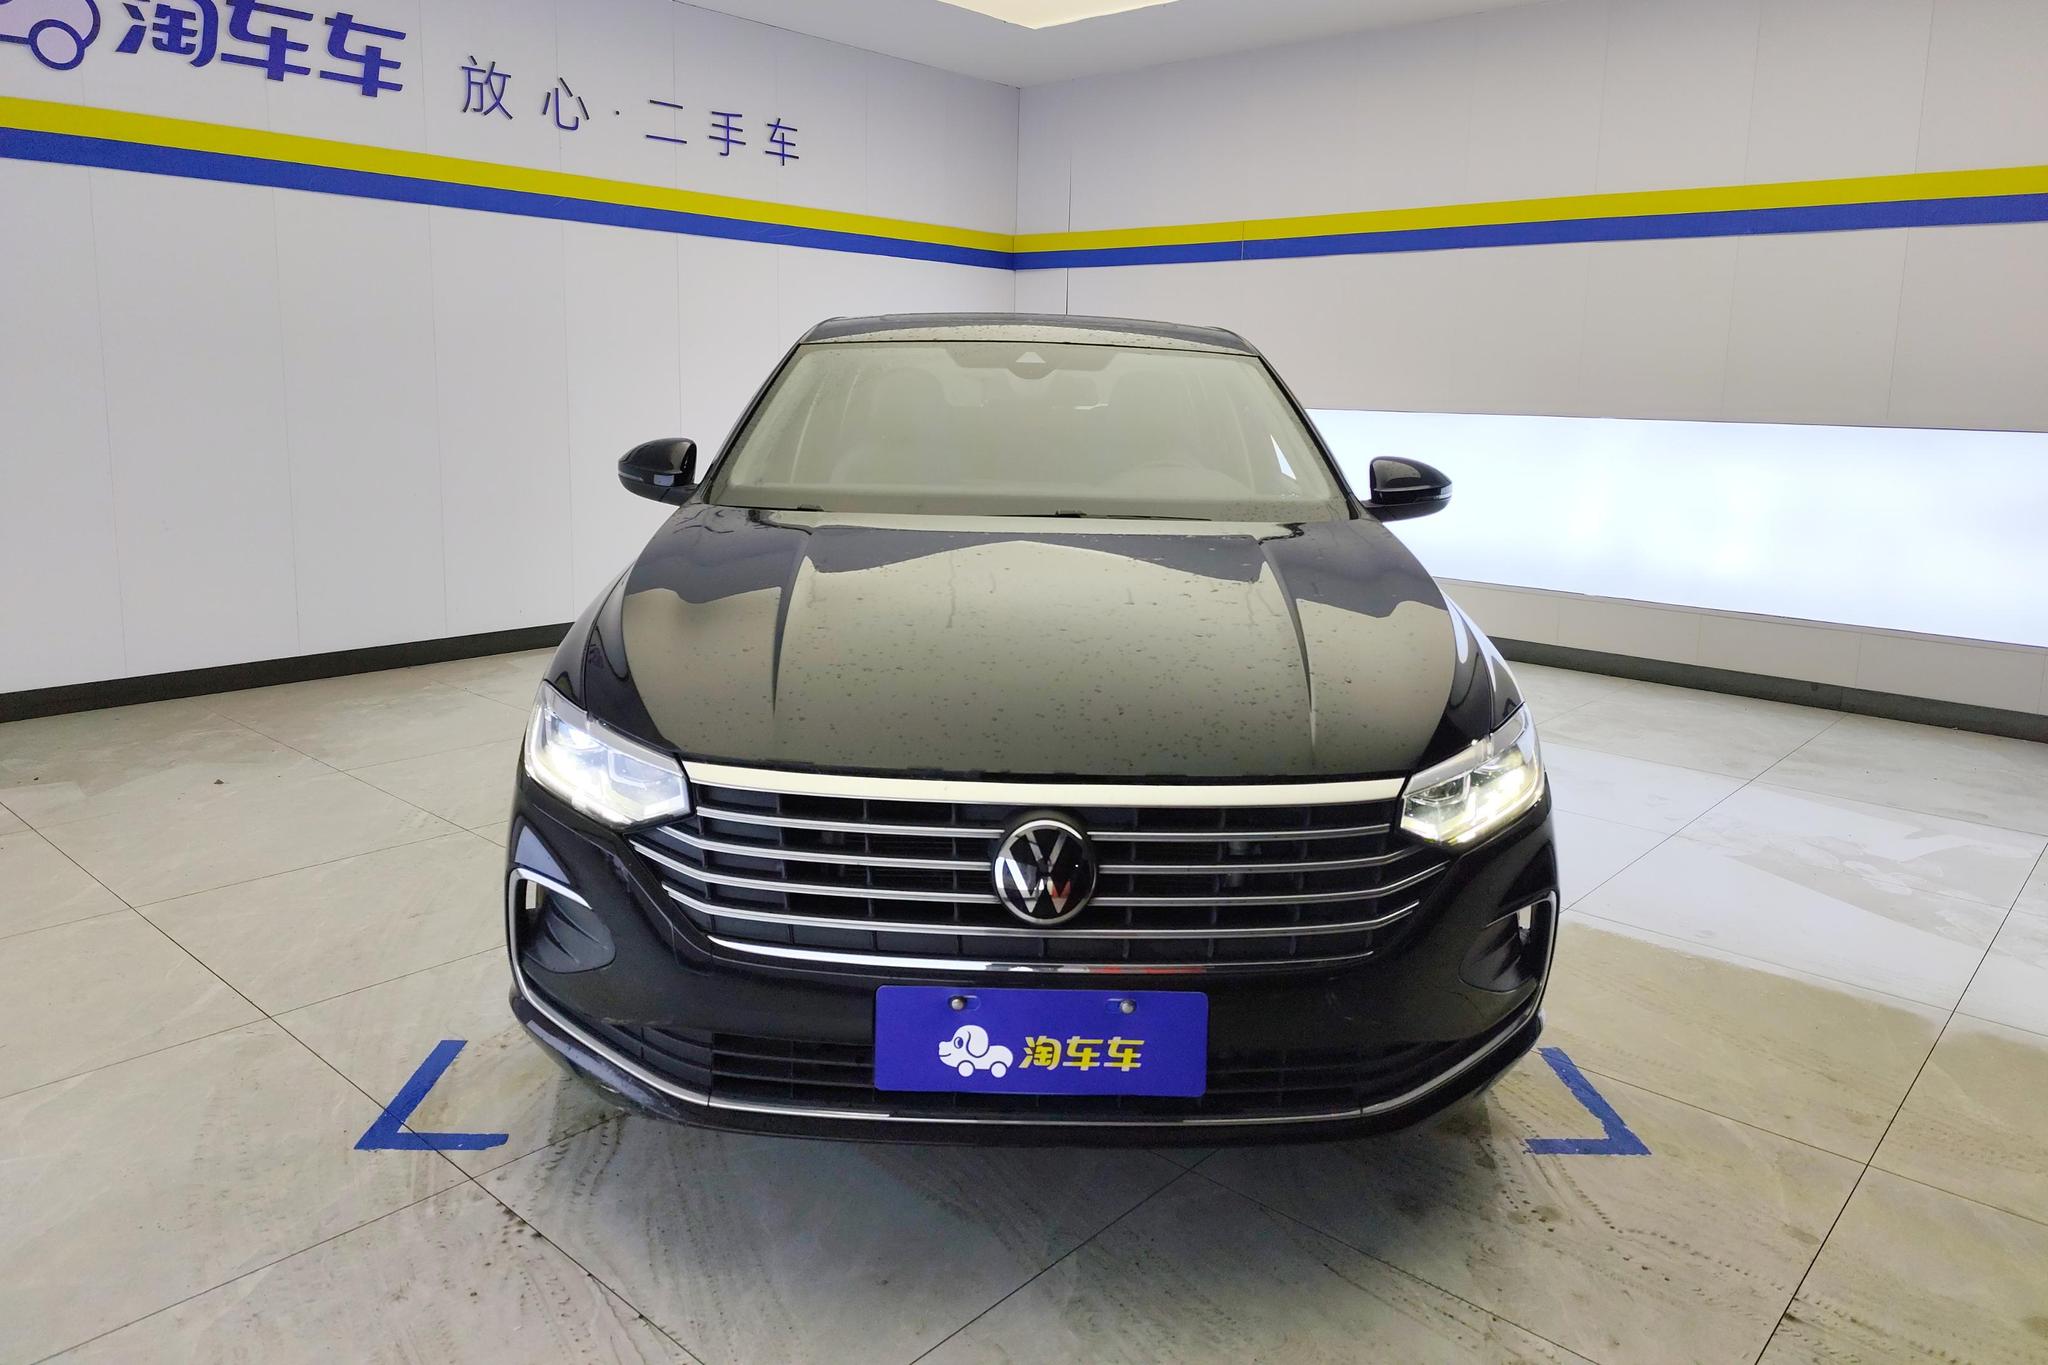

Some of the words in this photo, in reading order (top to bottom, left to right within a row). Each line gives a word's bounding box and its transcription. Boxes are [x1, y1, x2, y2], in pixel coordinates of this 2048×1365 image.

[115, 0, 407, 98] 淘车车
[1018, 1035, 1145, 1072] 淘车车
